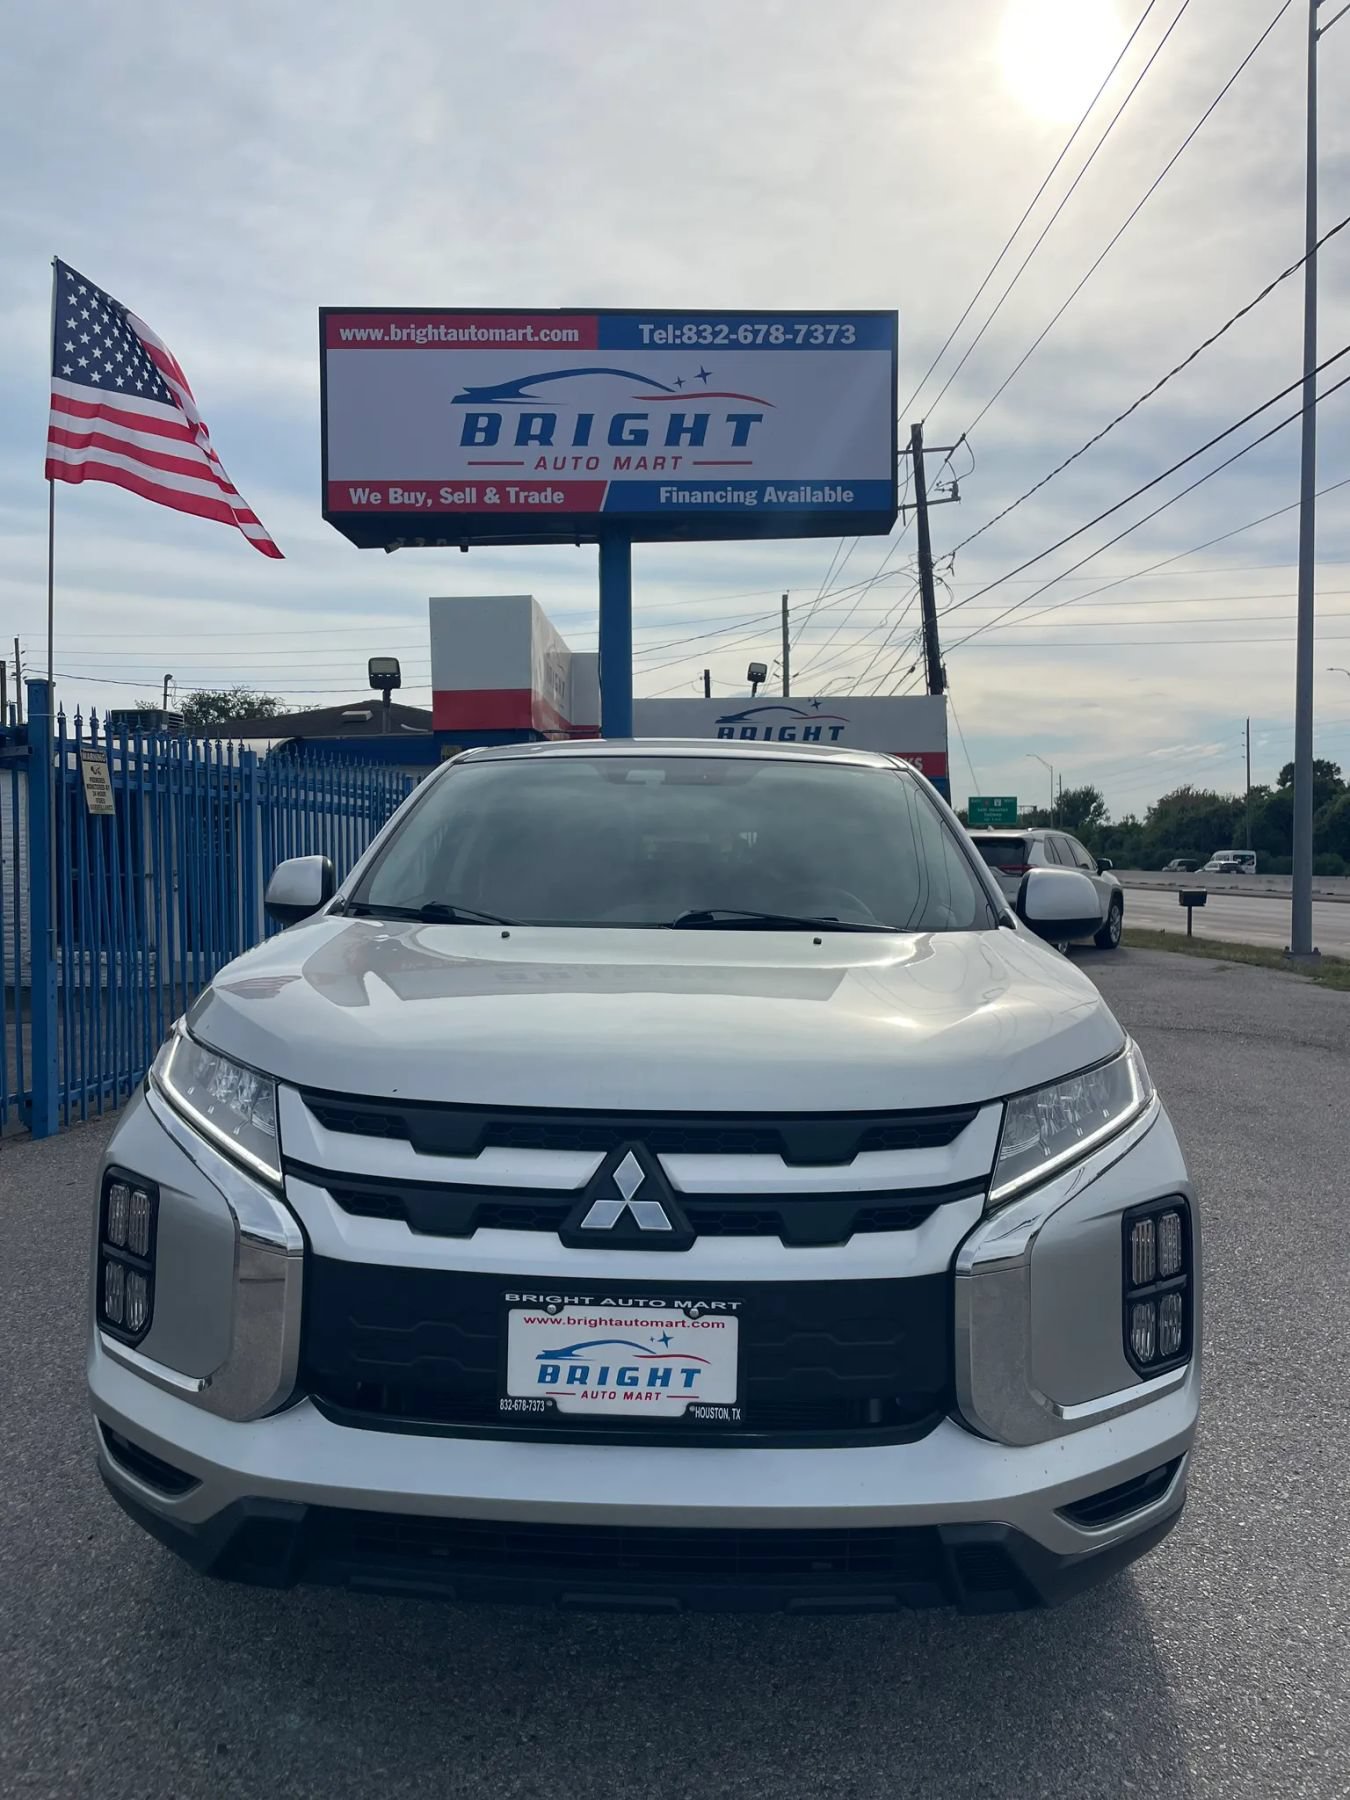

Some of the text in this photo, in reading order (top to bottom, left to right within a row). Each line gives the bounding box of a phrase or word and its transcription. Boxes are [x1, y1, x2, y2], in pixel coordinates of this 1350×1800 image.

[339, 324, 579, 344] www.brightautomart.com
[638, 324, 856, 345] Tel:832-678-7373
[460, 412, 764, 447] BRIGHT
[534, 456, 683, 471] AUTO MART
[349, 486, 565, 507] We Buy, Sell & Trade
[660, 485, 855, 506] Financing Available
[717, 726, 845, 741] BRIGHT
[505, 1293, 742, 1310] BRIGHT AUTO MART
[523, 1316, 726, 1329] www.brightautomart.com
[537, 1364, 702, 1388] BRIGHT
[581, 1390, 662, 1401] AUTO MART
[499, 1398, 545, 1412] 832-678-7373
[695, 1406, 741, 1421] HOUSTON, TX
